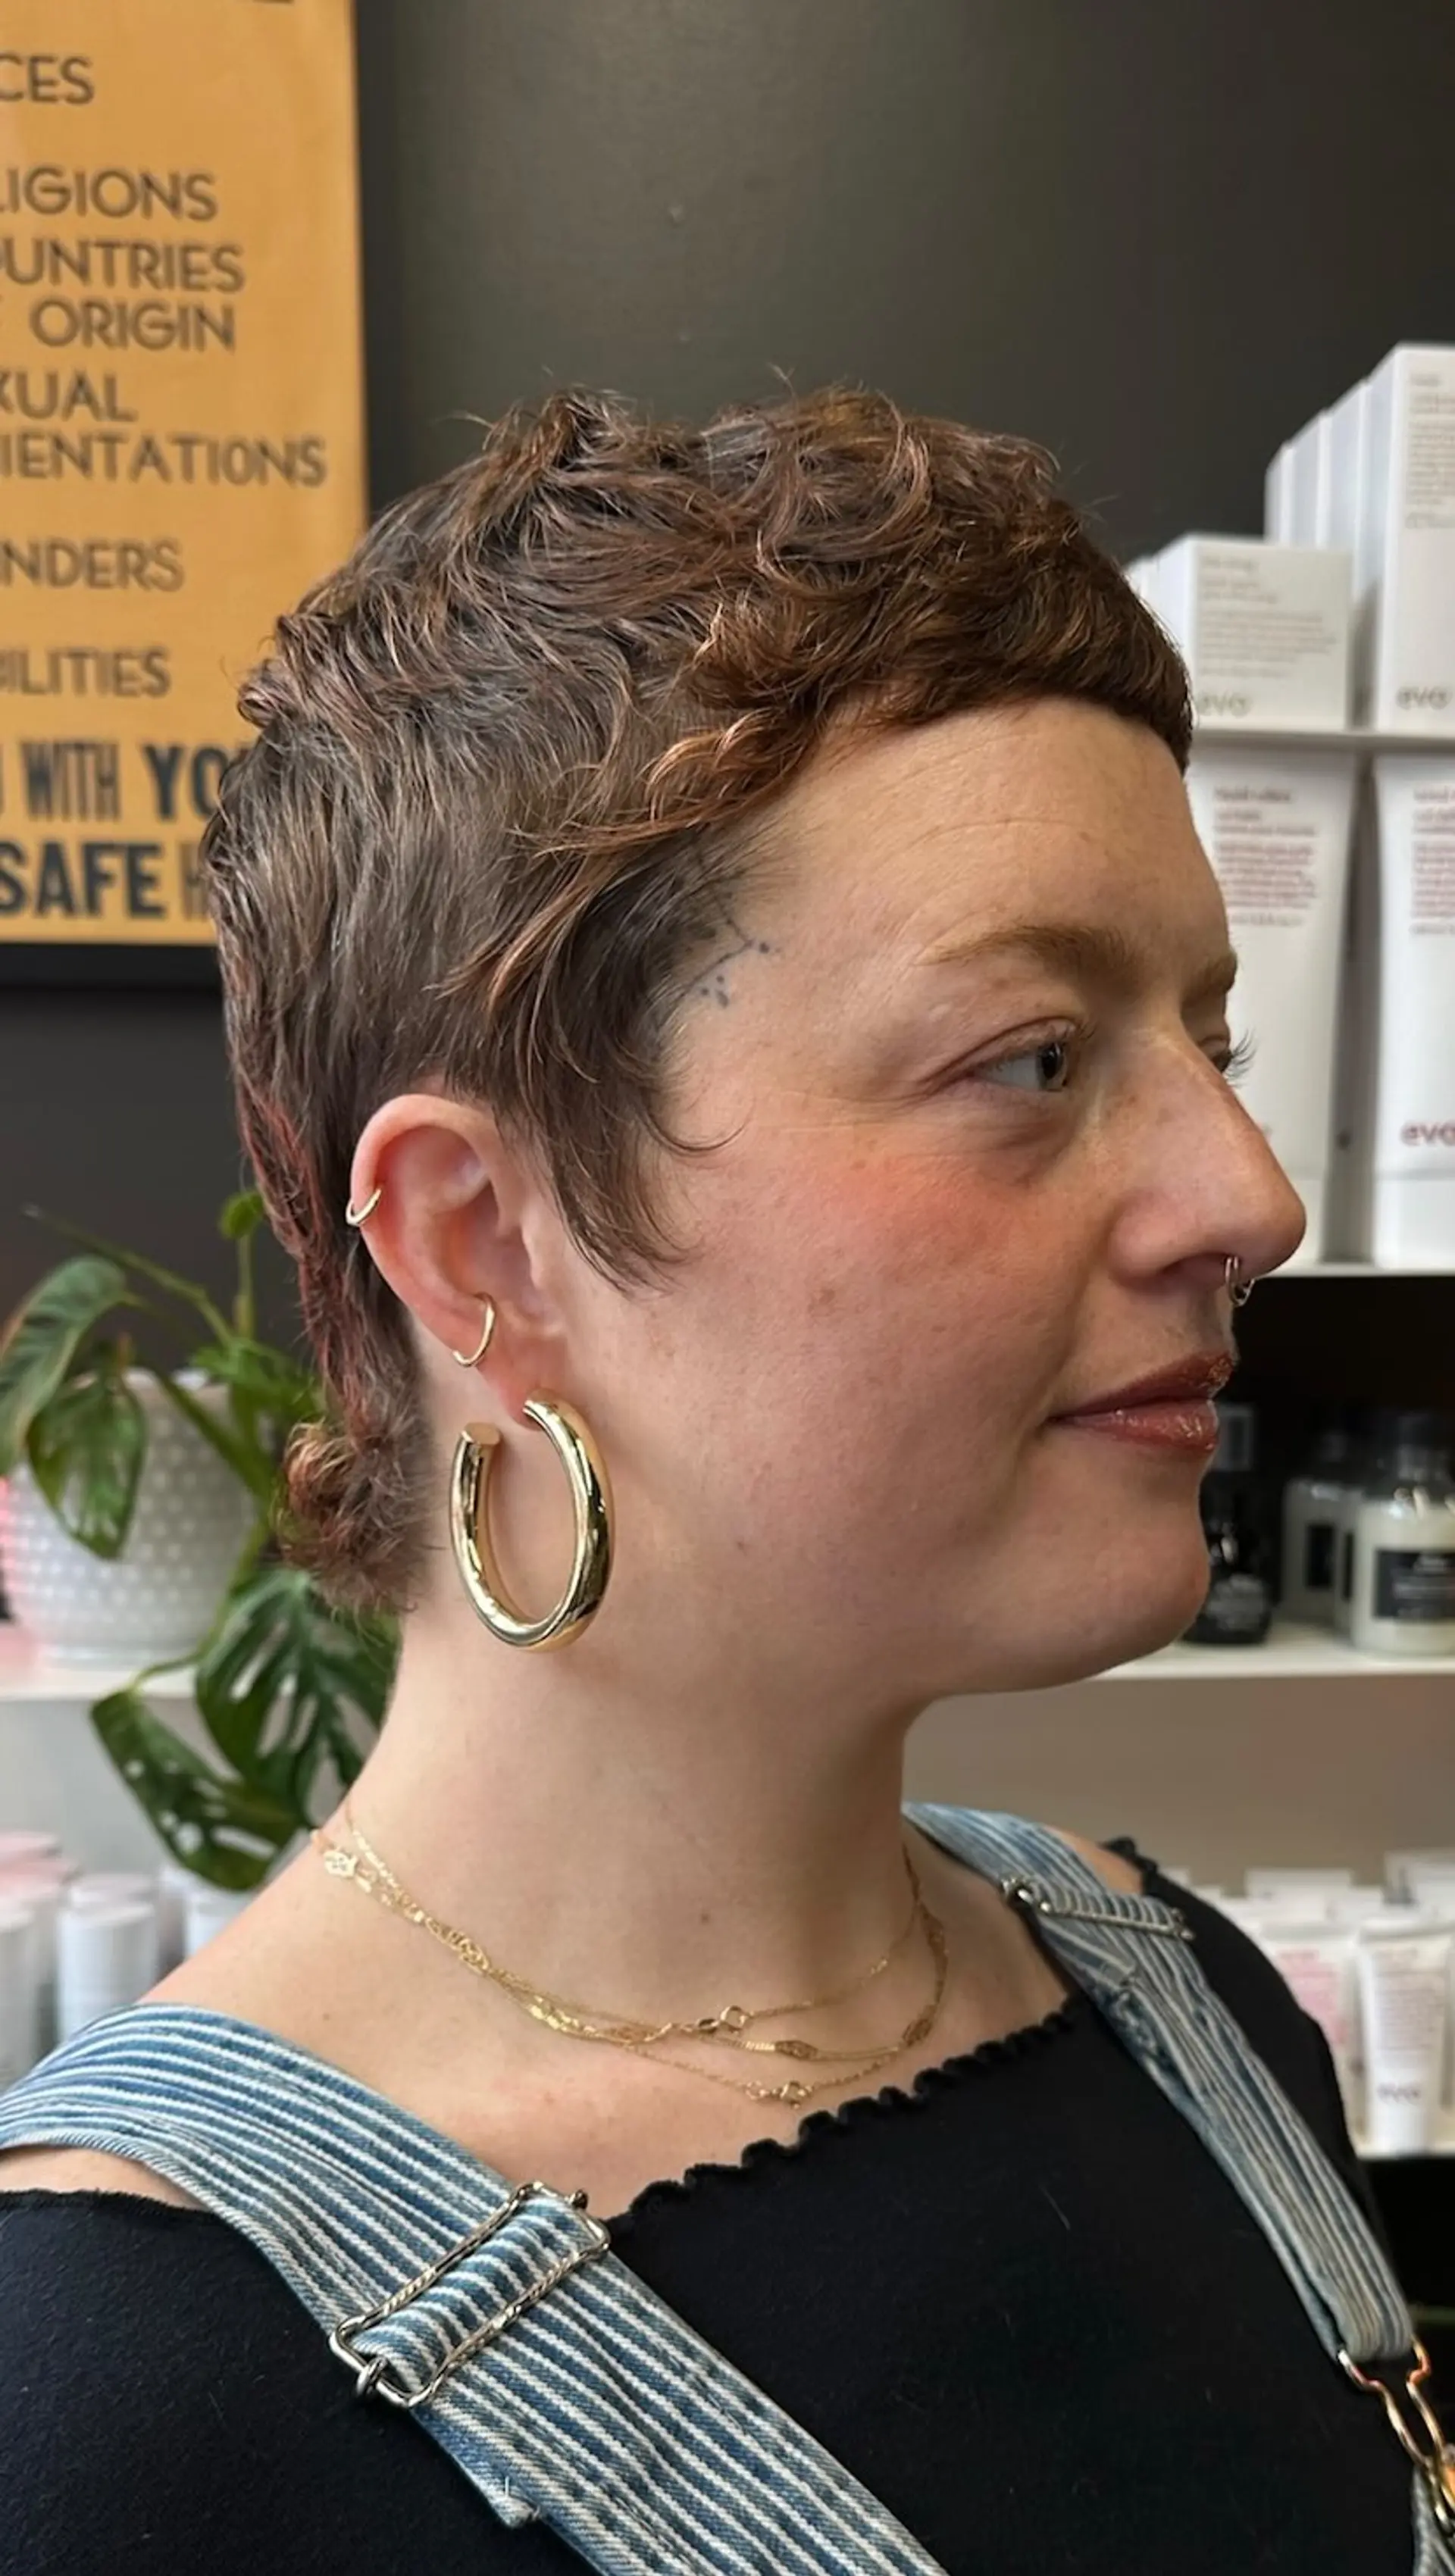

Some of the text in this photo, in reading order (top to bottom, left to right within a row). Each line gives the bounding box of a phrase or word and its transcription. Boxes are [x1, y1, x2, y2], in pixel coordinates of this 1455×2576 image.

[0, 166, 217, 222] IGIONS
[0, 236, 244, 292] UNTRIES
[30, 298, 236, 353] ORIGIN
[0, 537, 184, 592] NDERS
[20, 740, 120, 821] WITH
[0, 840, 165, 919] SAFE
